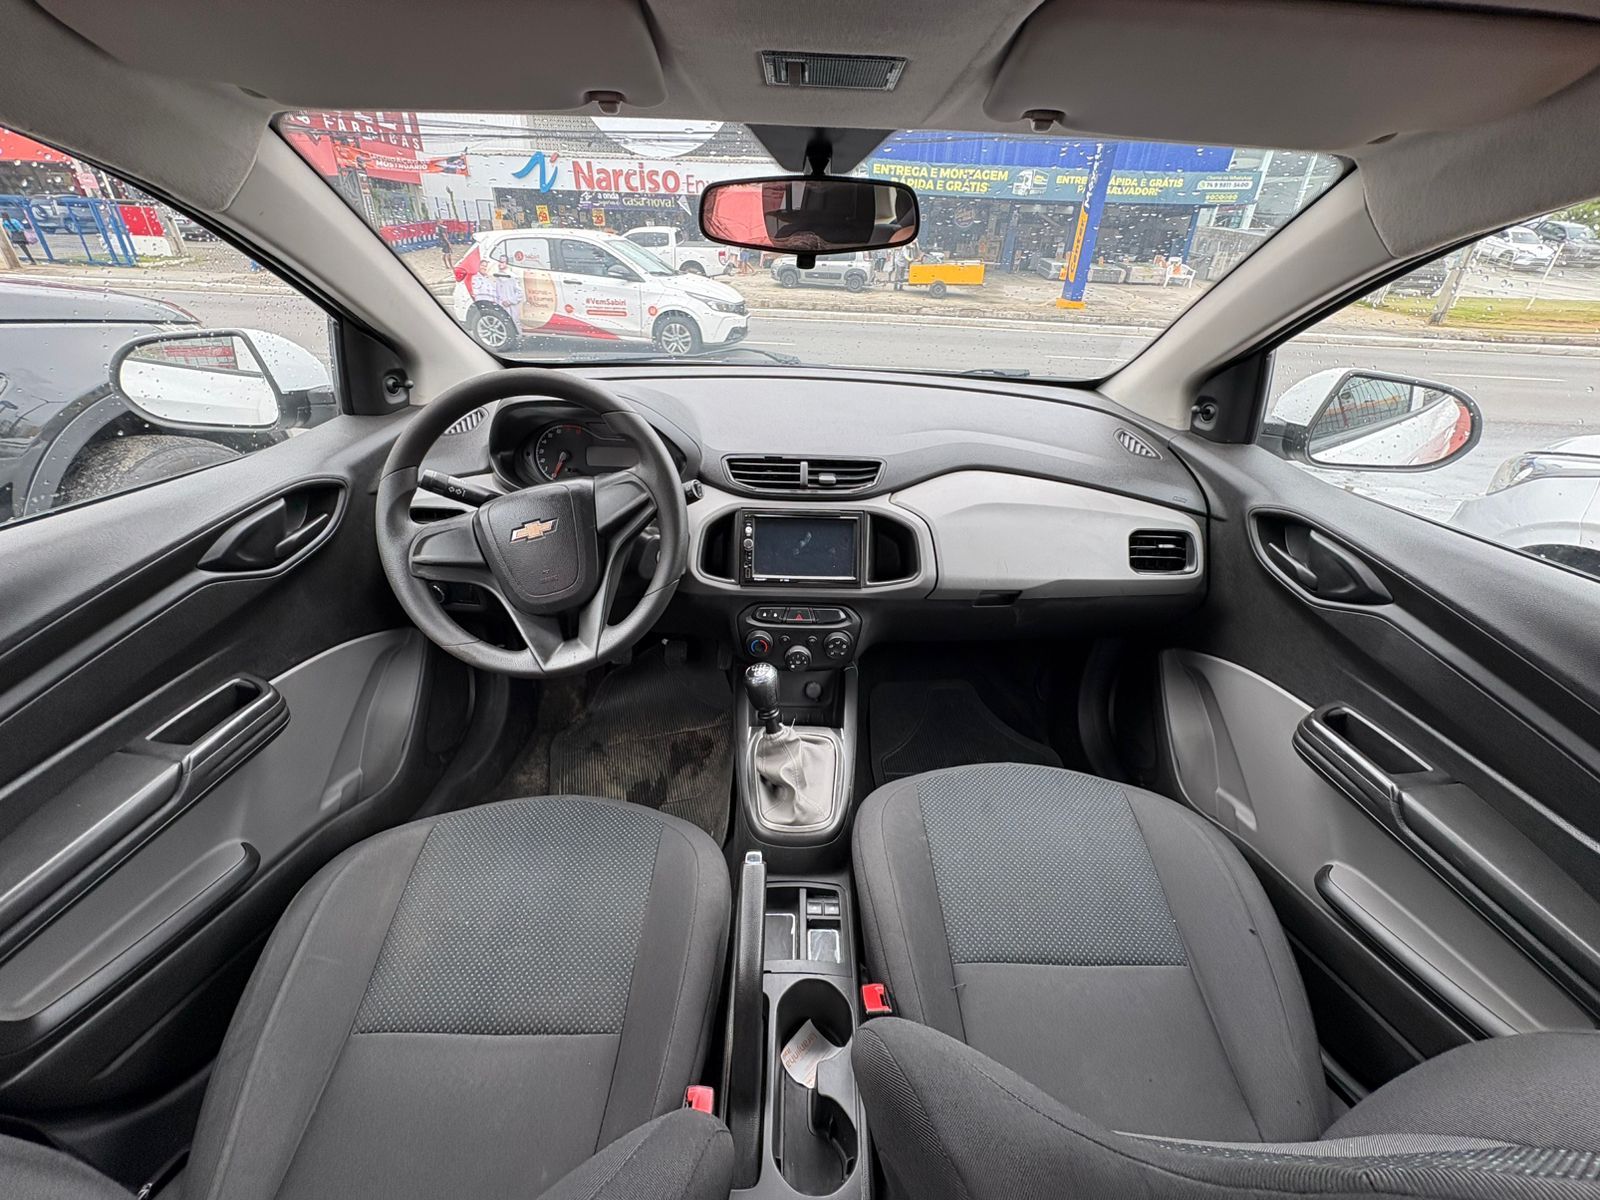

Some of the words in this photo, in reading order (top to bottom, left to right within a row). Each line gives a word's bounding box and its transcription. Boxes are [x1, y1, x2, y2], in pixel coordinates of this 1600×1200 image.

[572, 160, 680, 193] Narciso
[872, 164, 928, 178] ENTREGA
[930, 167, 938, 178] E
[940, 167, 1009, 181] MONTAGEM
[936, 180, 943, 189] E
[946, 178, 988, 192] GRÁTIS
[1056, 175, 1088, 186] ENTRE
[1108, 175, 1138, 186] ÁPIDA
[1140, 178, 1147, 186] E
[1149, 176, 1184, 188] GRÁTIS
